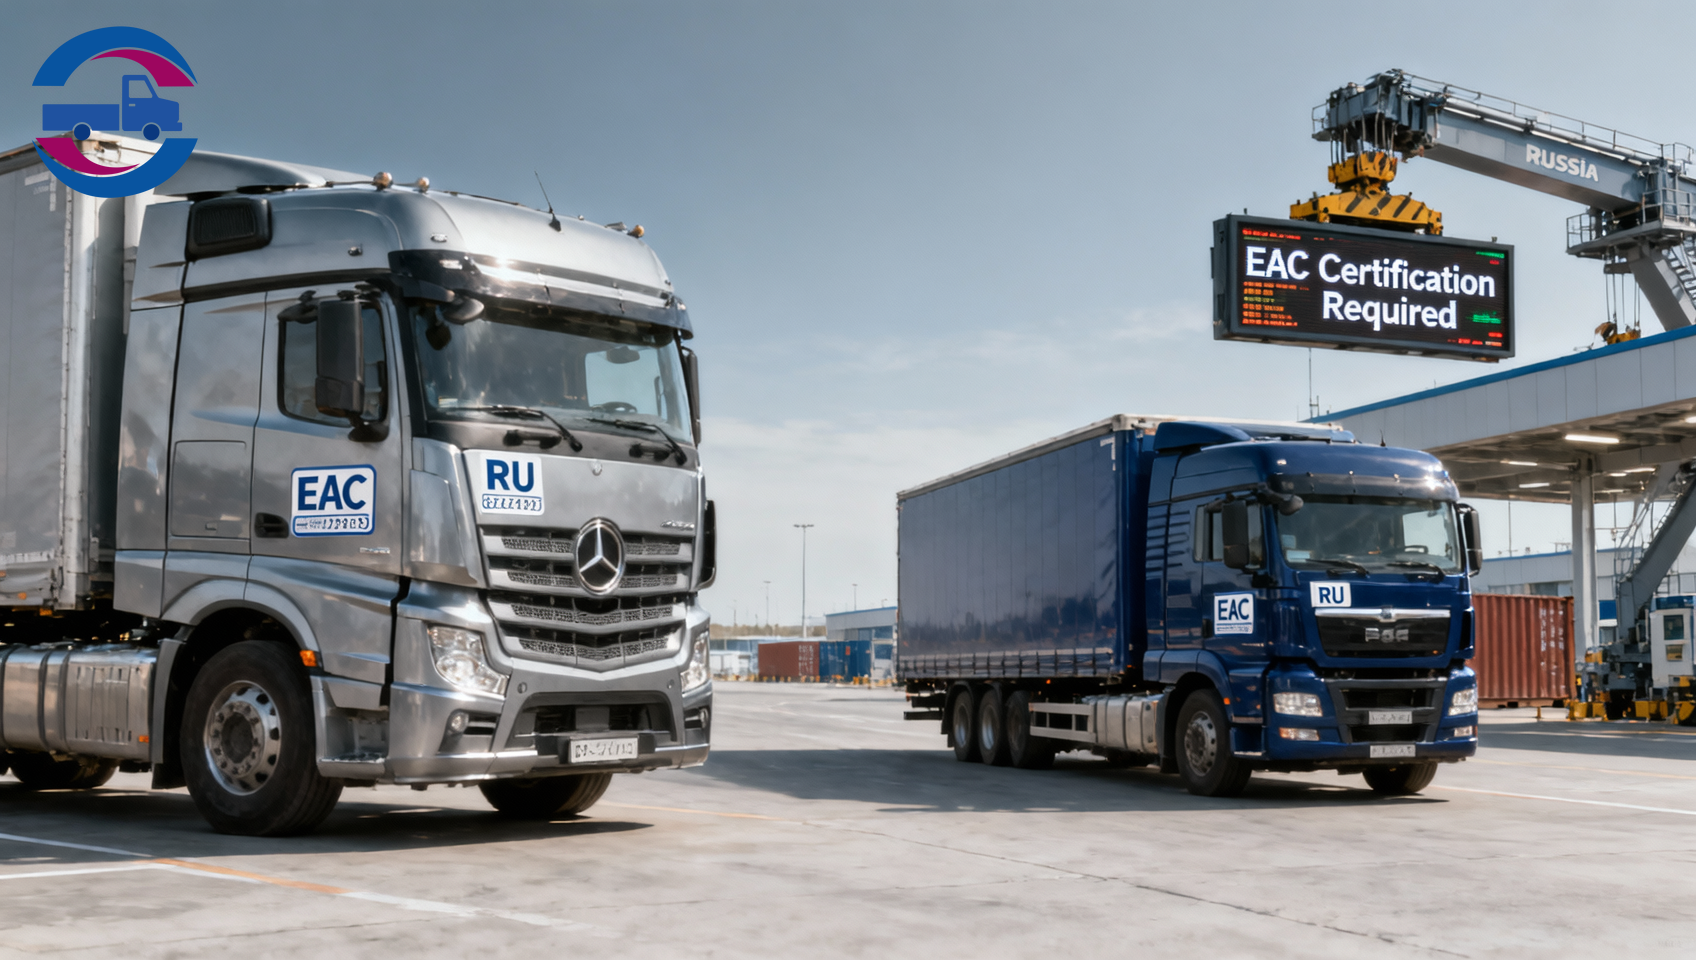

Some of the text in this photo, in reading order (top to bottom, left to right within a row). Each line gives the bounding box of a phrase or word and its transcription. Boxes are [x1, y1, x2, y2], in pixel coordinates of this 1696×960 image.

[1526, 143, 1599, 182] RUSSIA
[1246, 246, 1495, 297] EAC Certification
[1323, 290, 1457, 331] Required
[297, 473, 368, 511] EAC
[486, 458, 535, 493] RU
[1217, 598, 1250, 621] EAC
[1318, 586, 1345, 604] RU
